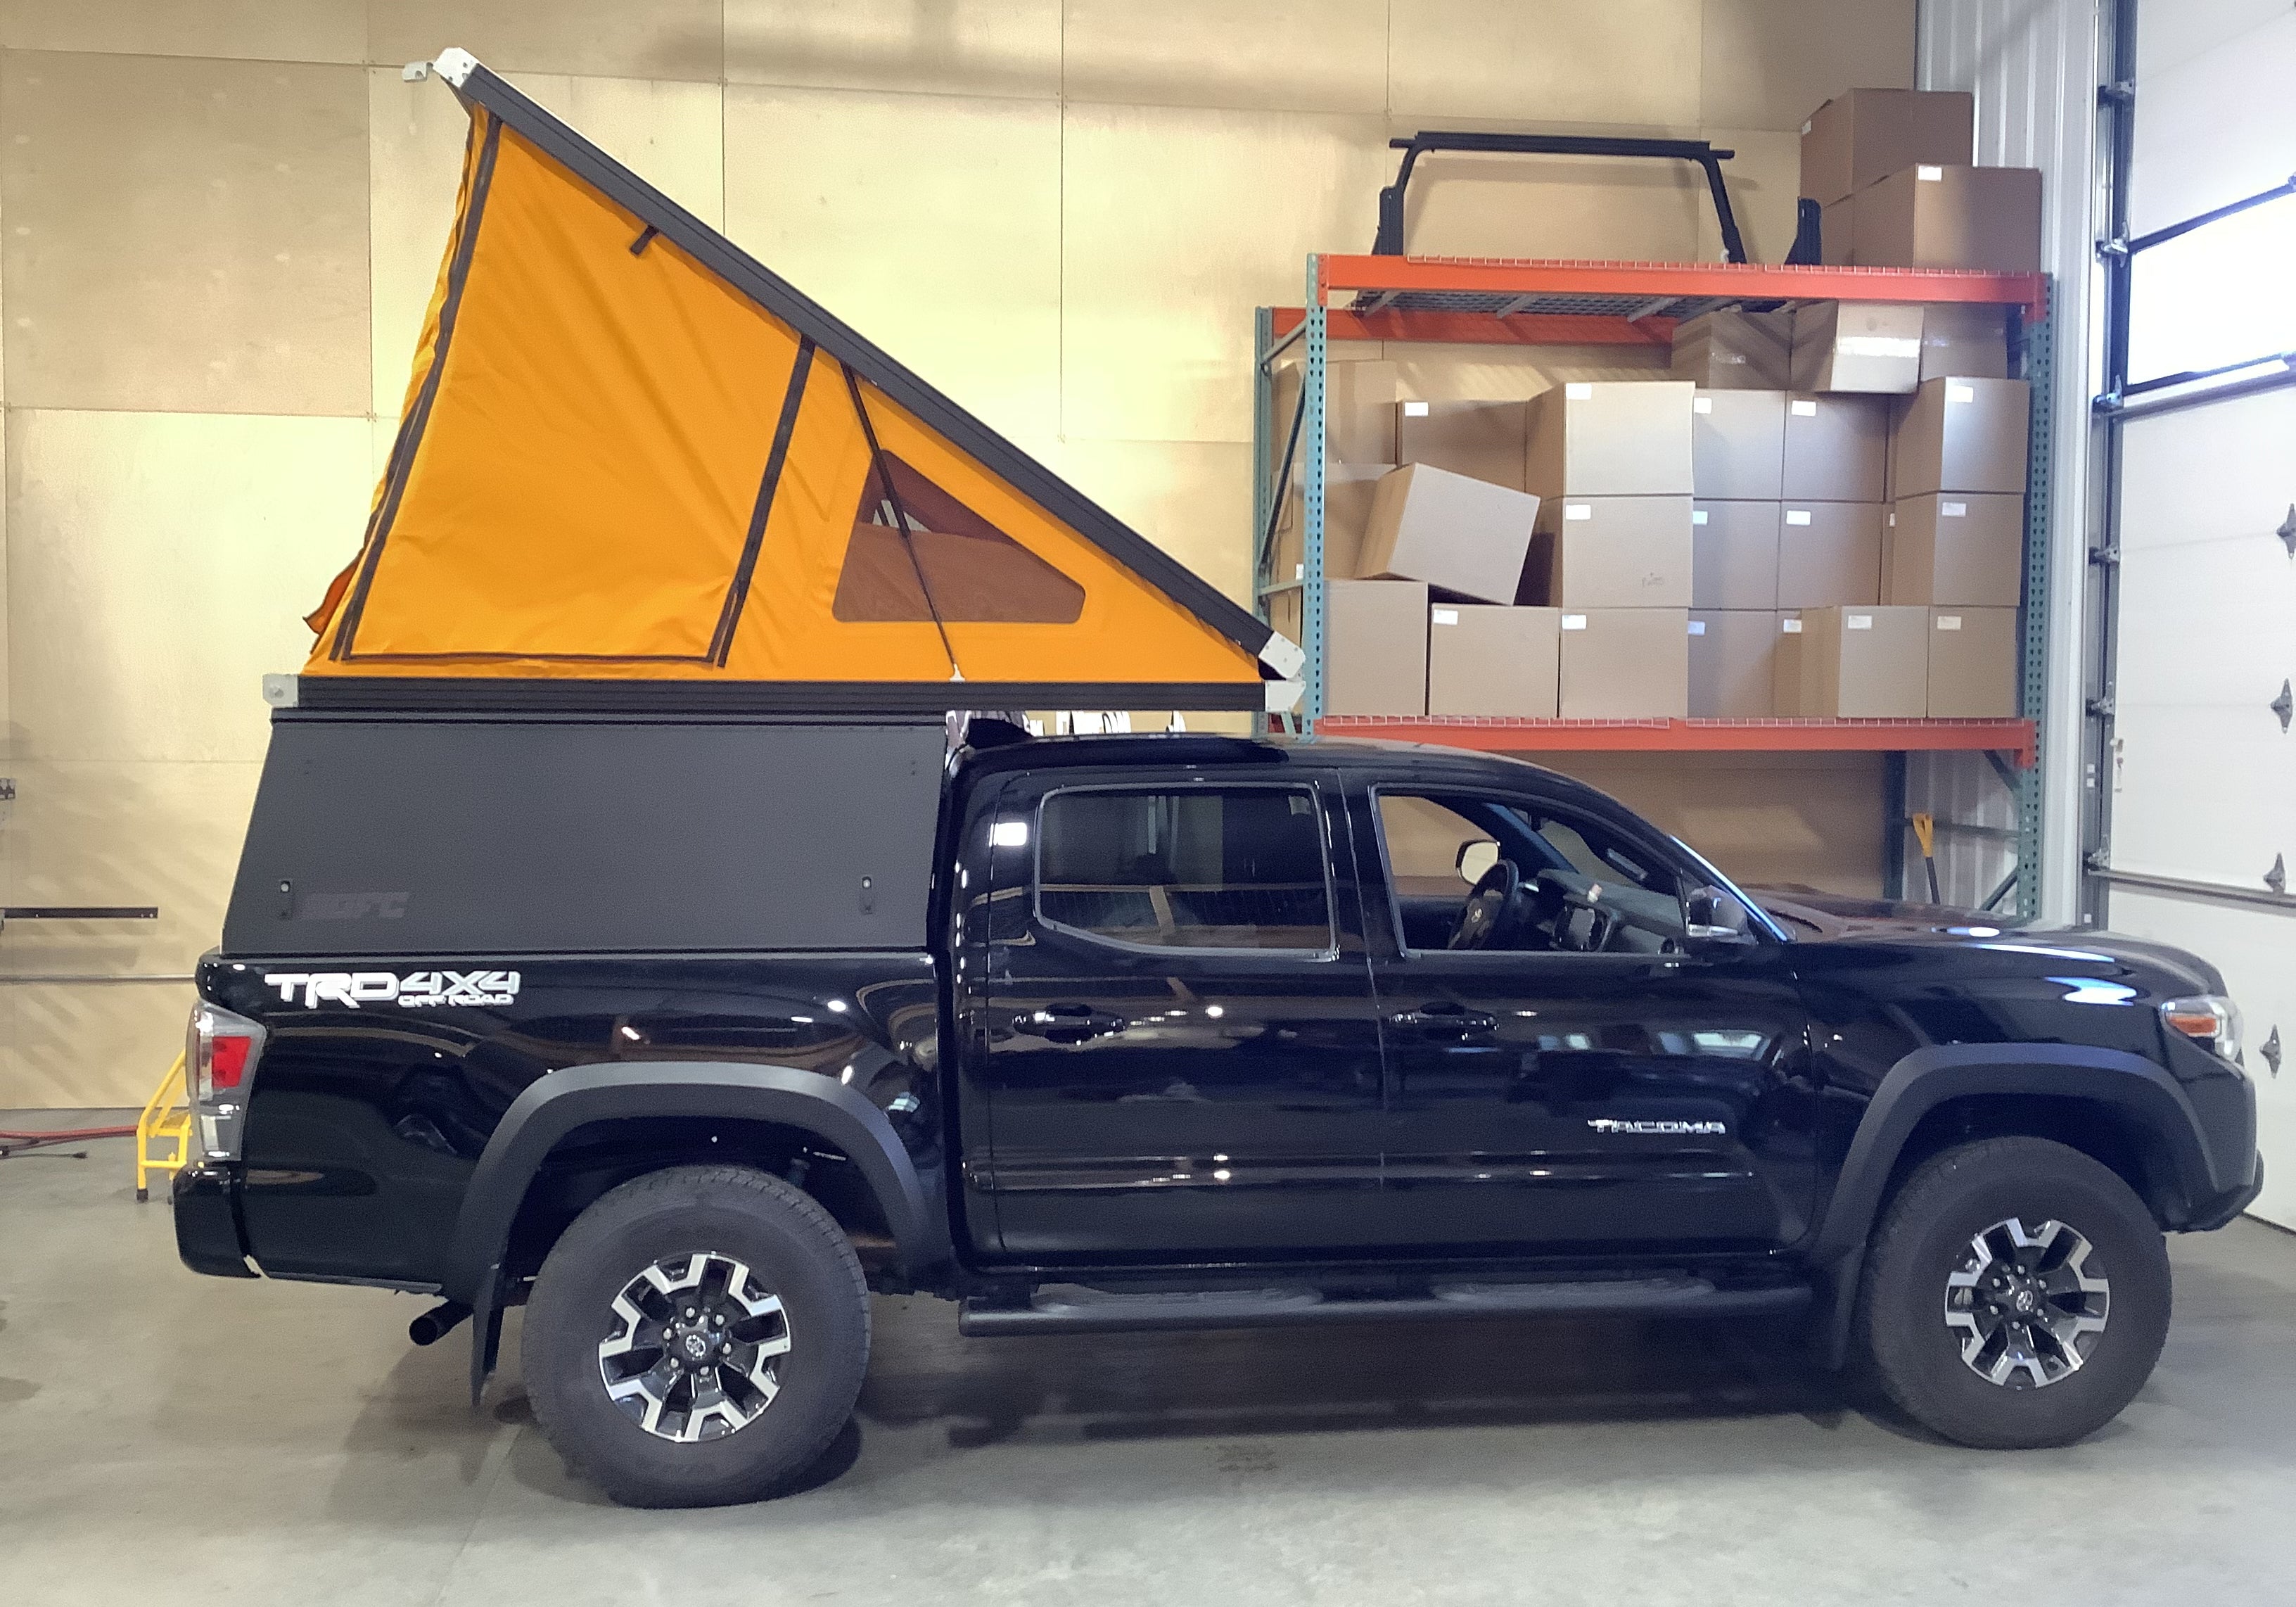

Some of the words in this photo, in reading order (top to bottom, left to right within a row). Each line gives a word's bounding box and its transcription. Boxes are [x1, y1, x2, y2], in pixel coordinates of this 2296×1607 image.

[264, 972, 400, 1010] TRD
[397, 994, 447, 1008] OFF
[447, 993, 515, 1008] ROAD
[1587, 1119, 1726, 1134] TACOMA
